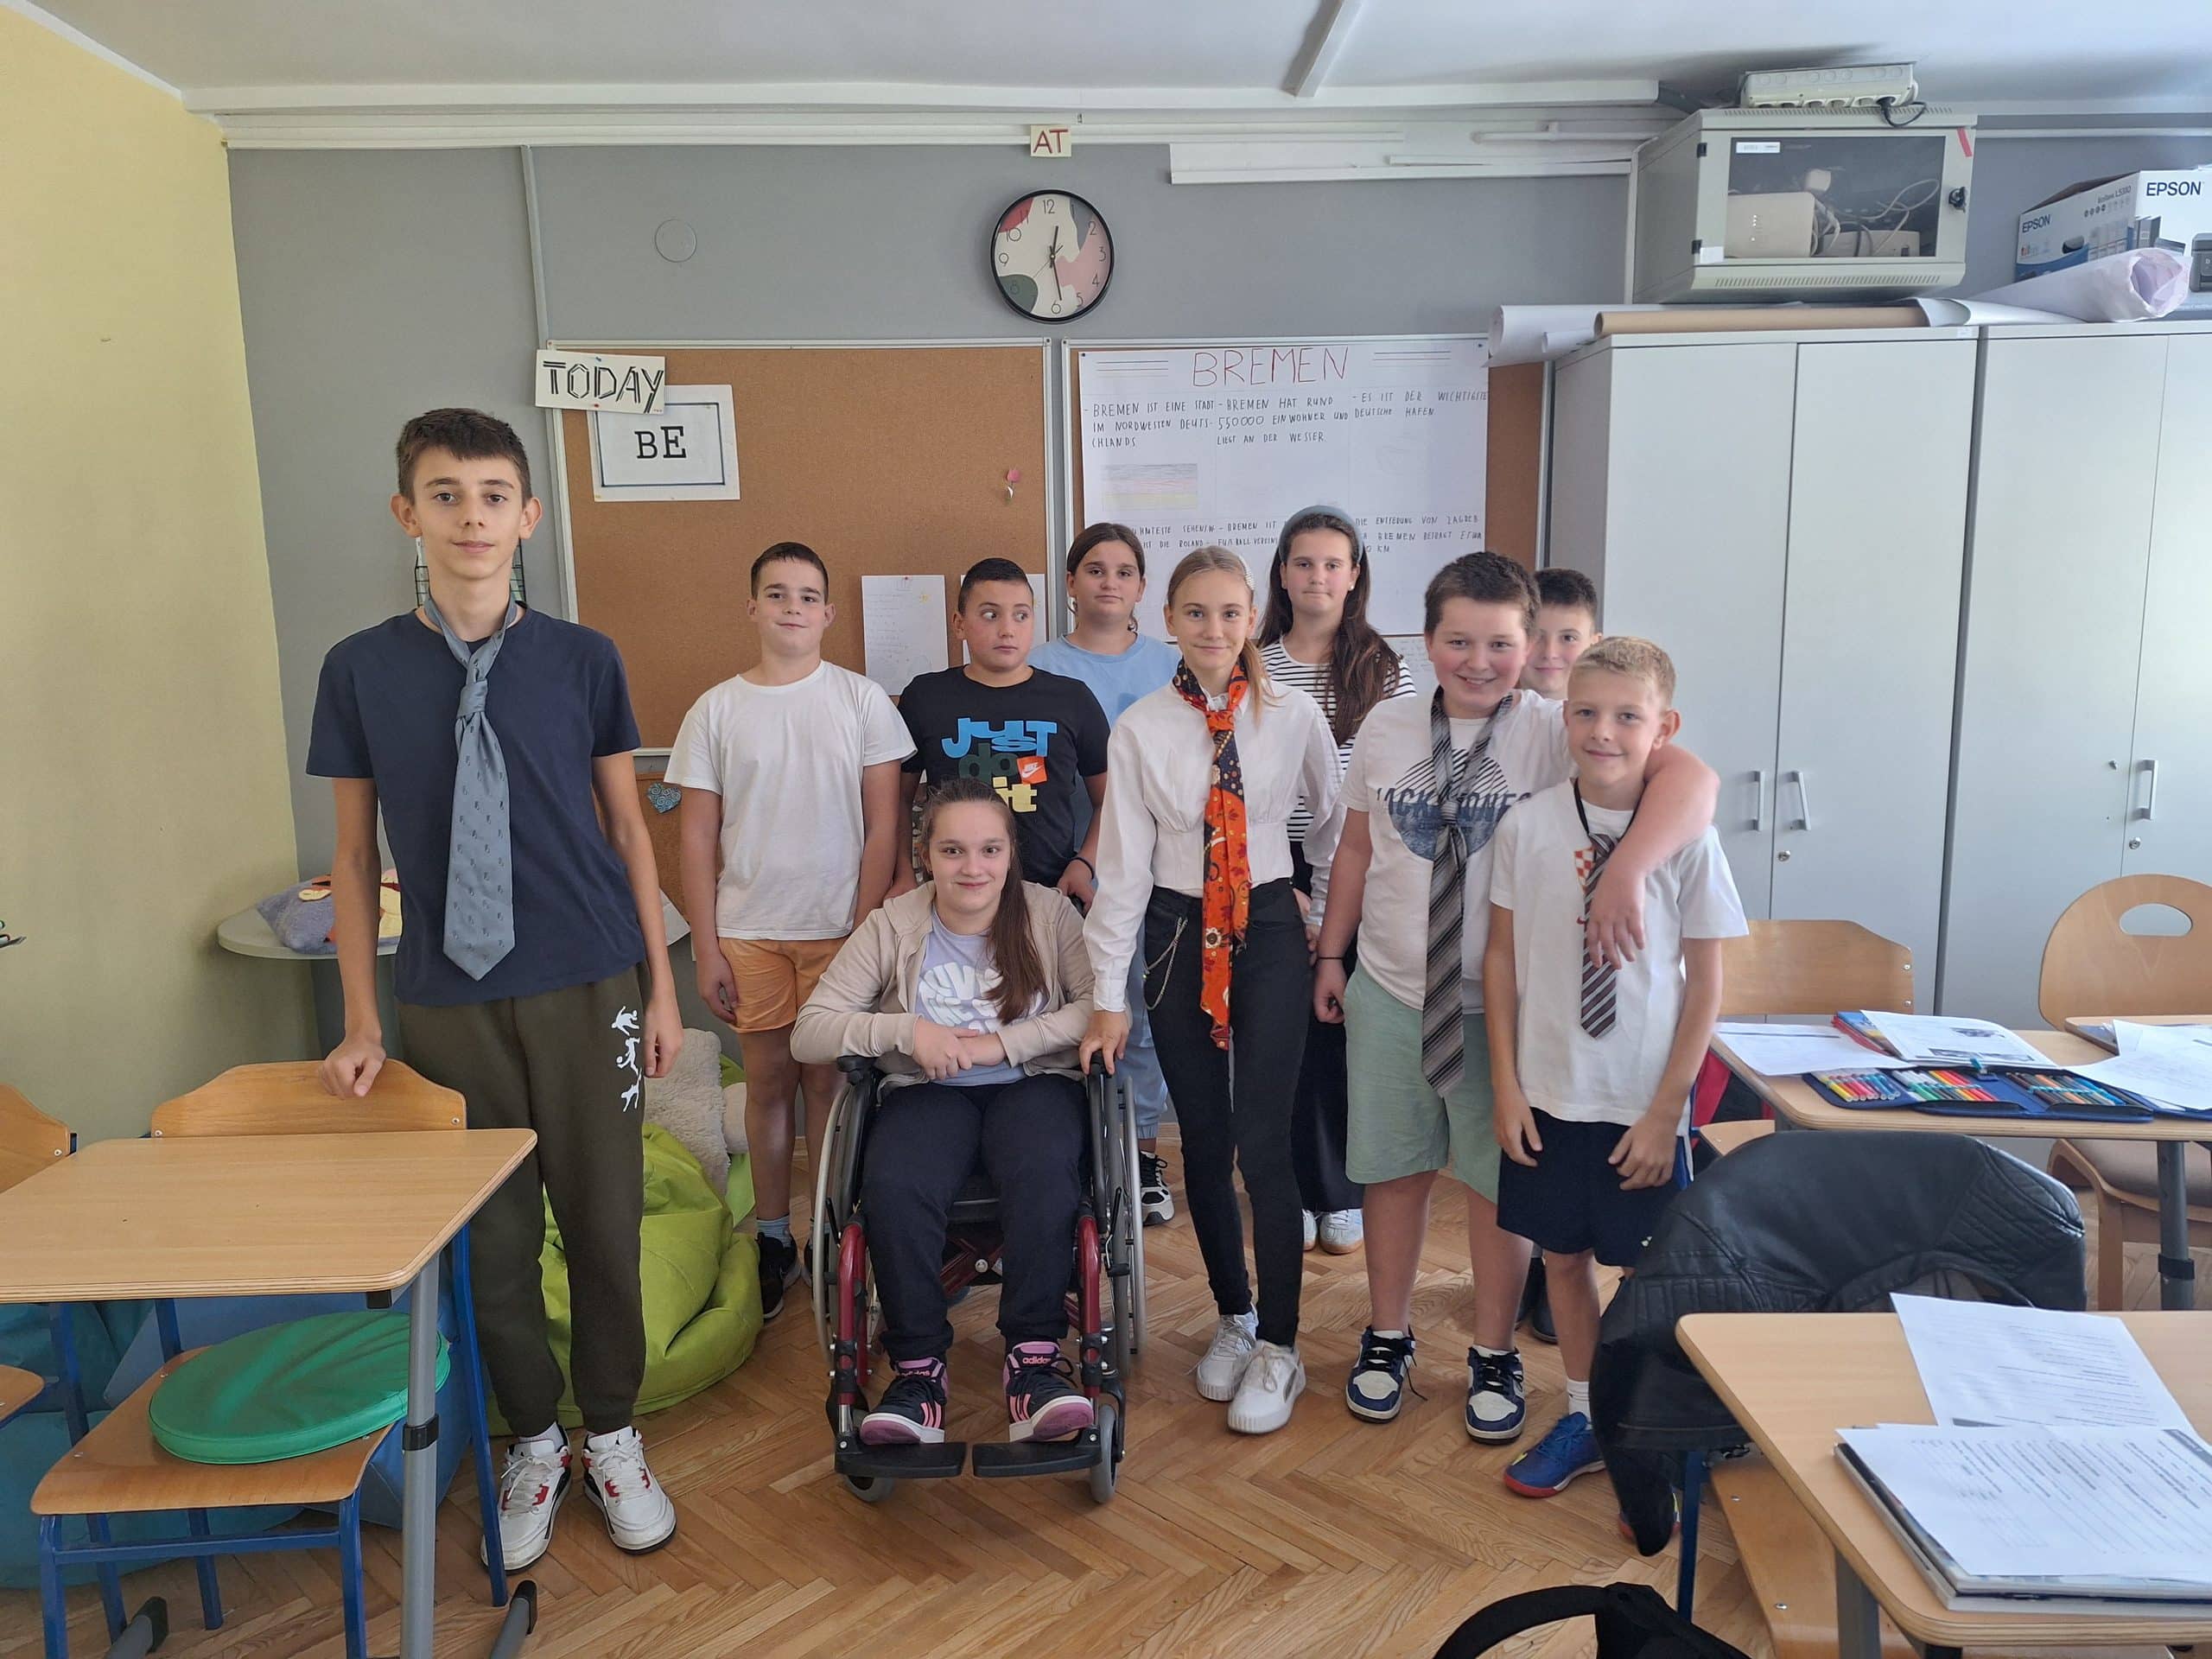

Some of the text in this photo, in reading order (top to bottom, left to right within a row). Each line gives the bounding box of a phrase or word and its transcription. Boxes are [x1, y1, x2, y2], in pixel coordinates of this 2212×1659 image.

[1033, 128, 1069, 154] AT
[2145, 181, 2202, 196] EPSON
[1042, 199, 1056, 215] 12
[1088, 220, 1097, 236] 2
[2021, 213, 2051, 233] EPSON
[1006, 226, 1022, 243] 10
[998, 252, 1009, 267] 9
[1098, 245, 1107, 263] 3
[1091, 272, 1100, 288] 4
[1051, 300, 1062, 315] 6
[1076, 291, 1084, 308] 5
[1193, 346, 1348, 386] BREMEN
[543, 360, 664, 414] TODAY
[1227, 397, 1333, 410] BREMEN HAT RUND
[1405, 391, 1423, 402] DER
[1093, 402, 1140, 417] BREMEN
[1147, 402, 1159, 414] IST
[1166, 401, 1186, 412] EINE
[1333, 410, 1349, 420] UND
[1093, 422, 1104, 432] IM
[634, 425, 687, 459] BE
[1243, 435, 1255, 443] AN
[1263, 433, 1278, 442] DER
